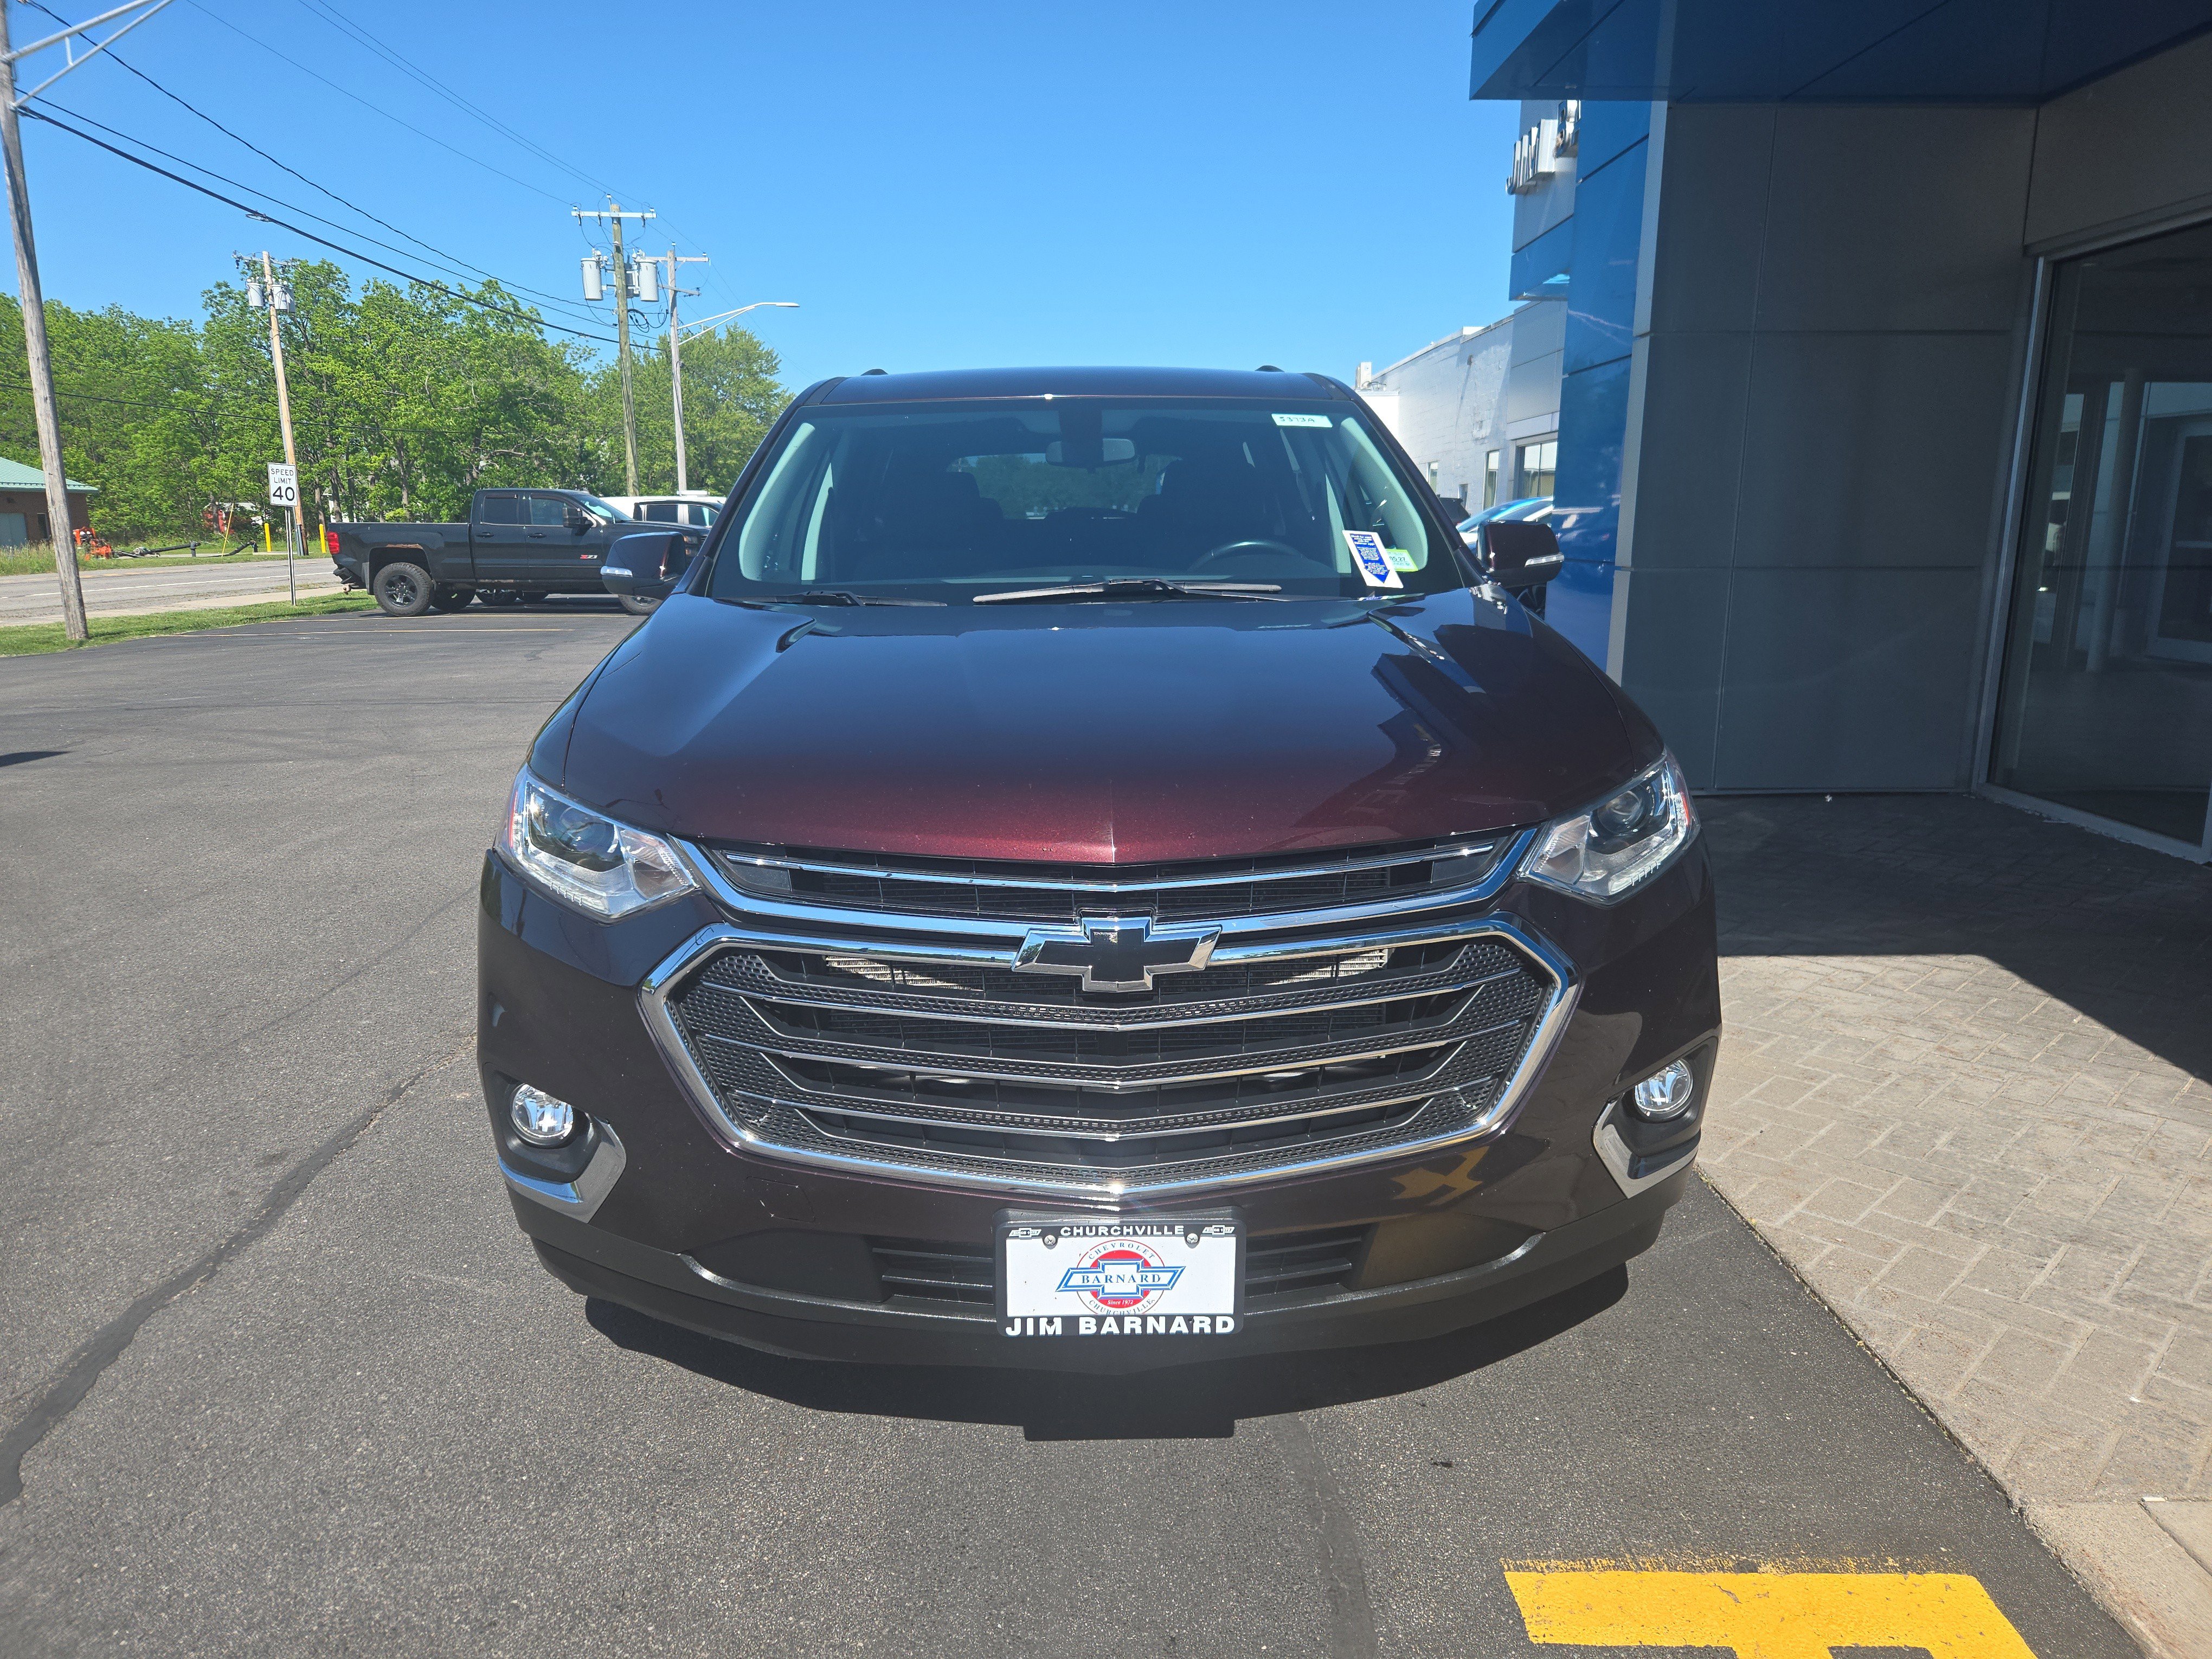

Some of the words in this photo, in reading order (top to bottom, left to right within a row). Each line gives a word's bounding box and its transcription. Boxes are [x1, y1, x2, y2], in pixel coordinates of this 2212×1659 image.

[272, 486, 295, 501] 40
[1060, 1225, 1185, 1237] CHURCHVILLE
[1089, 1242, 1155, 1260] CHEVROLET
[1081, 1274, 1161, 1284] BARNARD
[1005, 1317, 1063, 1336] JIM
[1078, 1315, 1236, 1335] BARNARD
